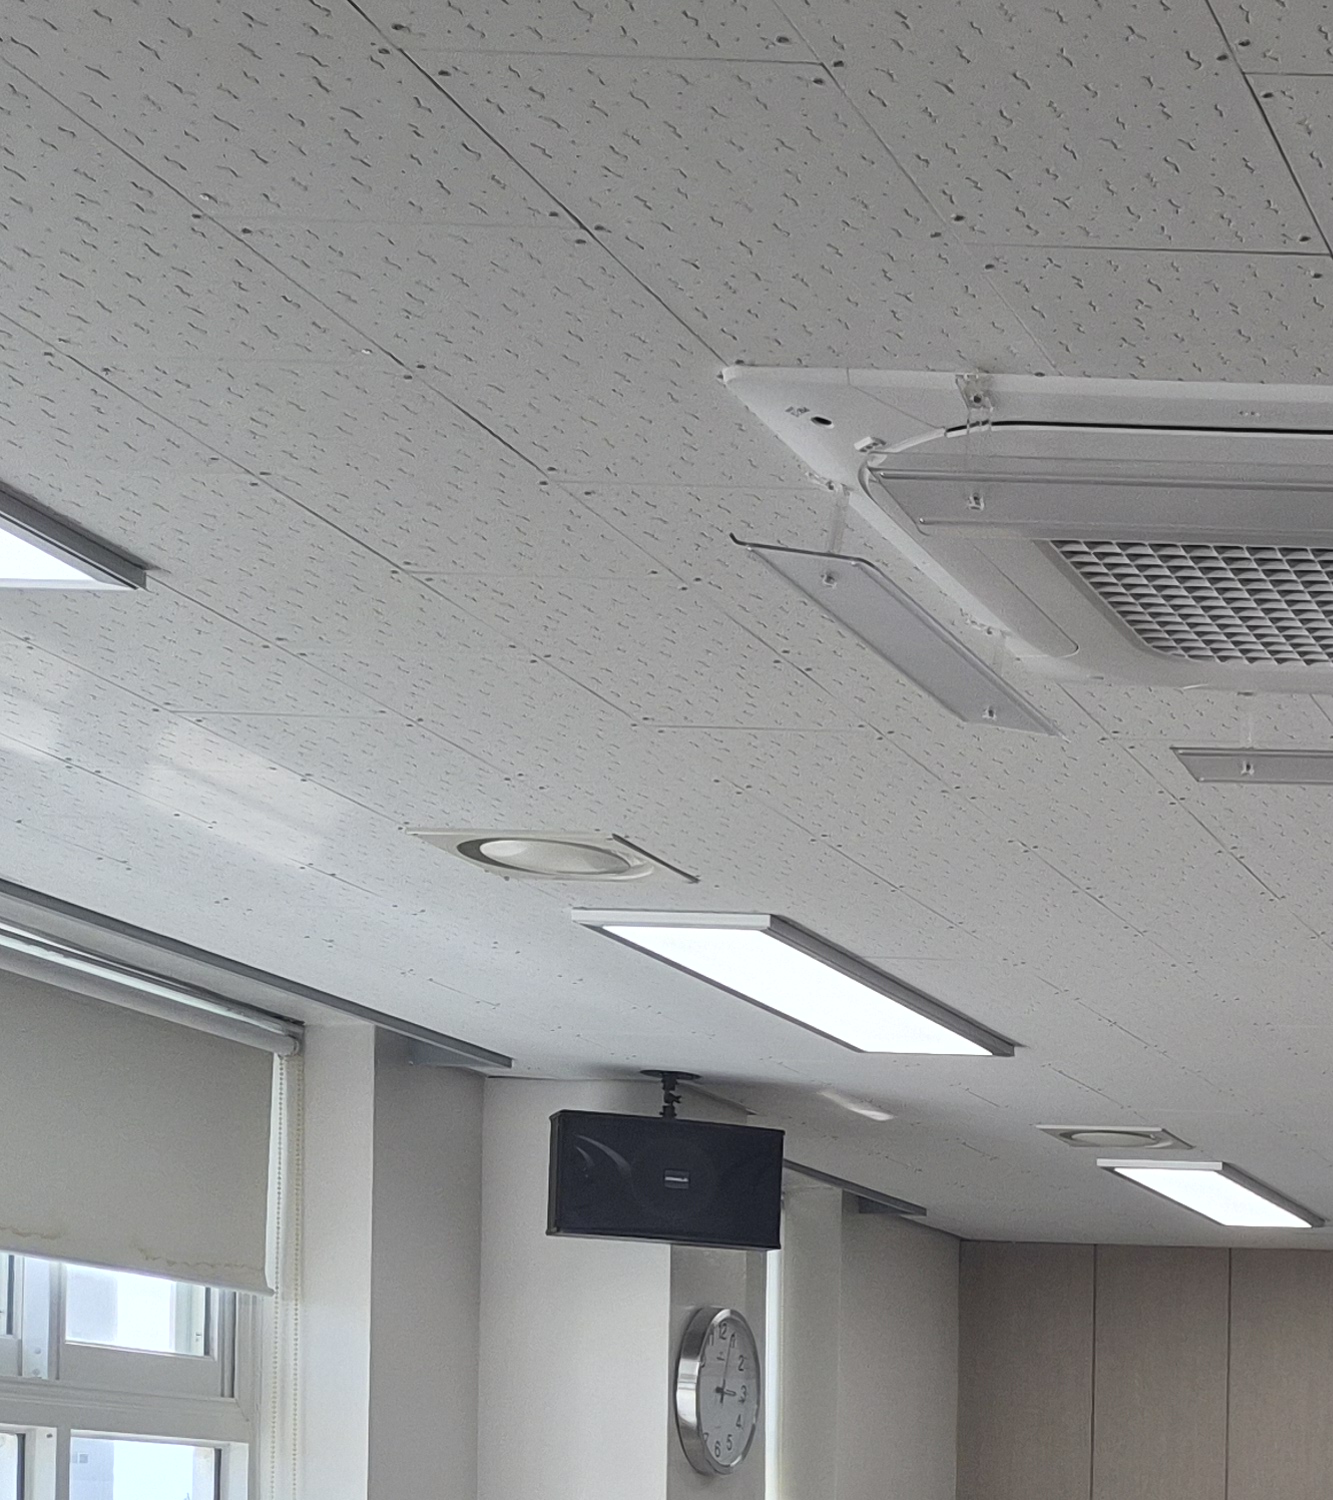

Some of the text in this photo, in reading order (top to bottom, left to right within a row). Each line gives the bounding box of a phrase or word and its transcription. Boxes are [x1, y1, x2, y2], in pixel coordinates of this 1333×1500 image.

[738, 1354, 746, 1372] 2
[741, 1384, 747, 1403] 3
[714, 1440, 721, 1458] 6
[726, 1434, 733, 1451] 5
